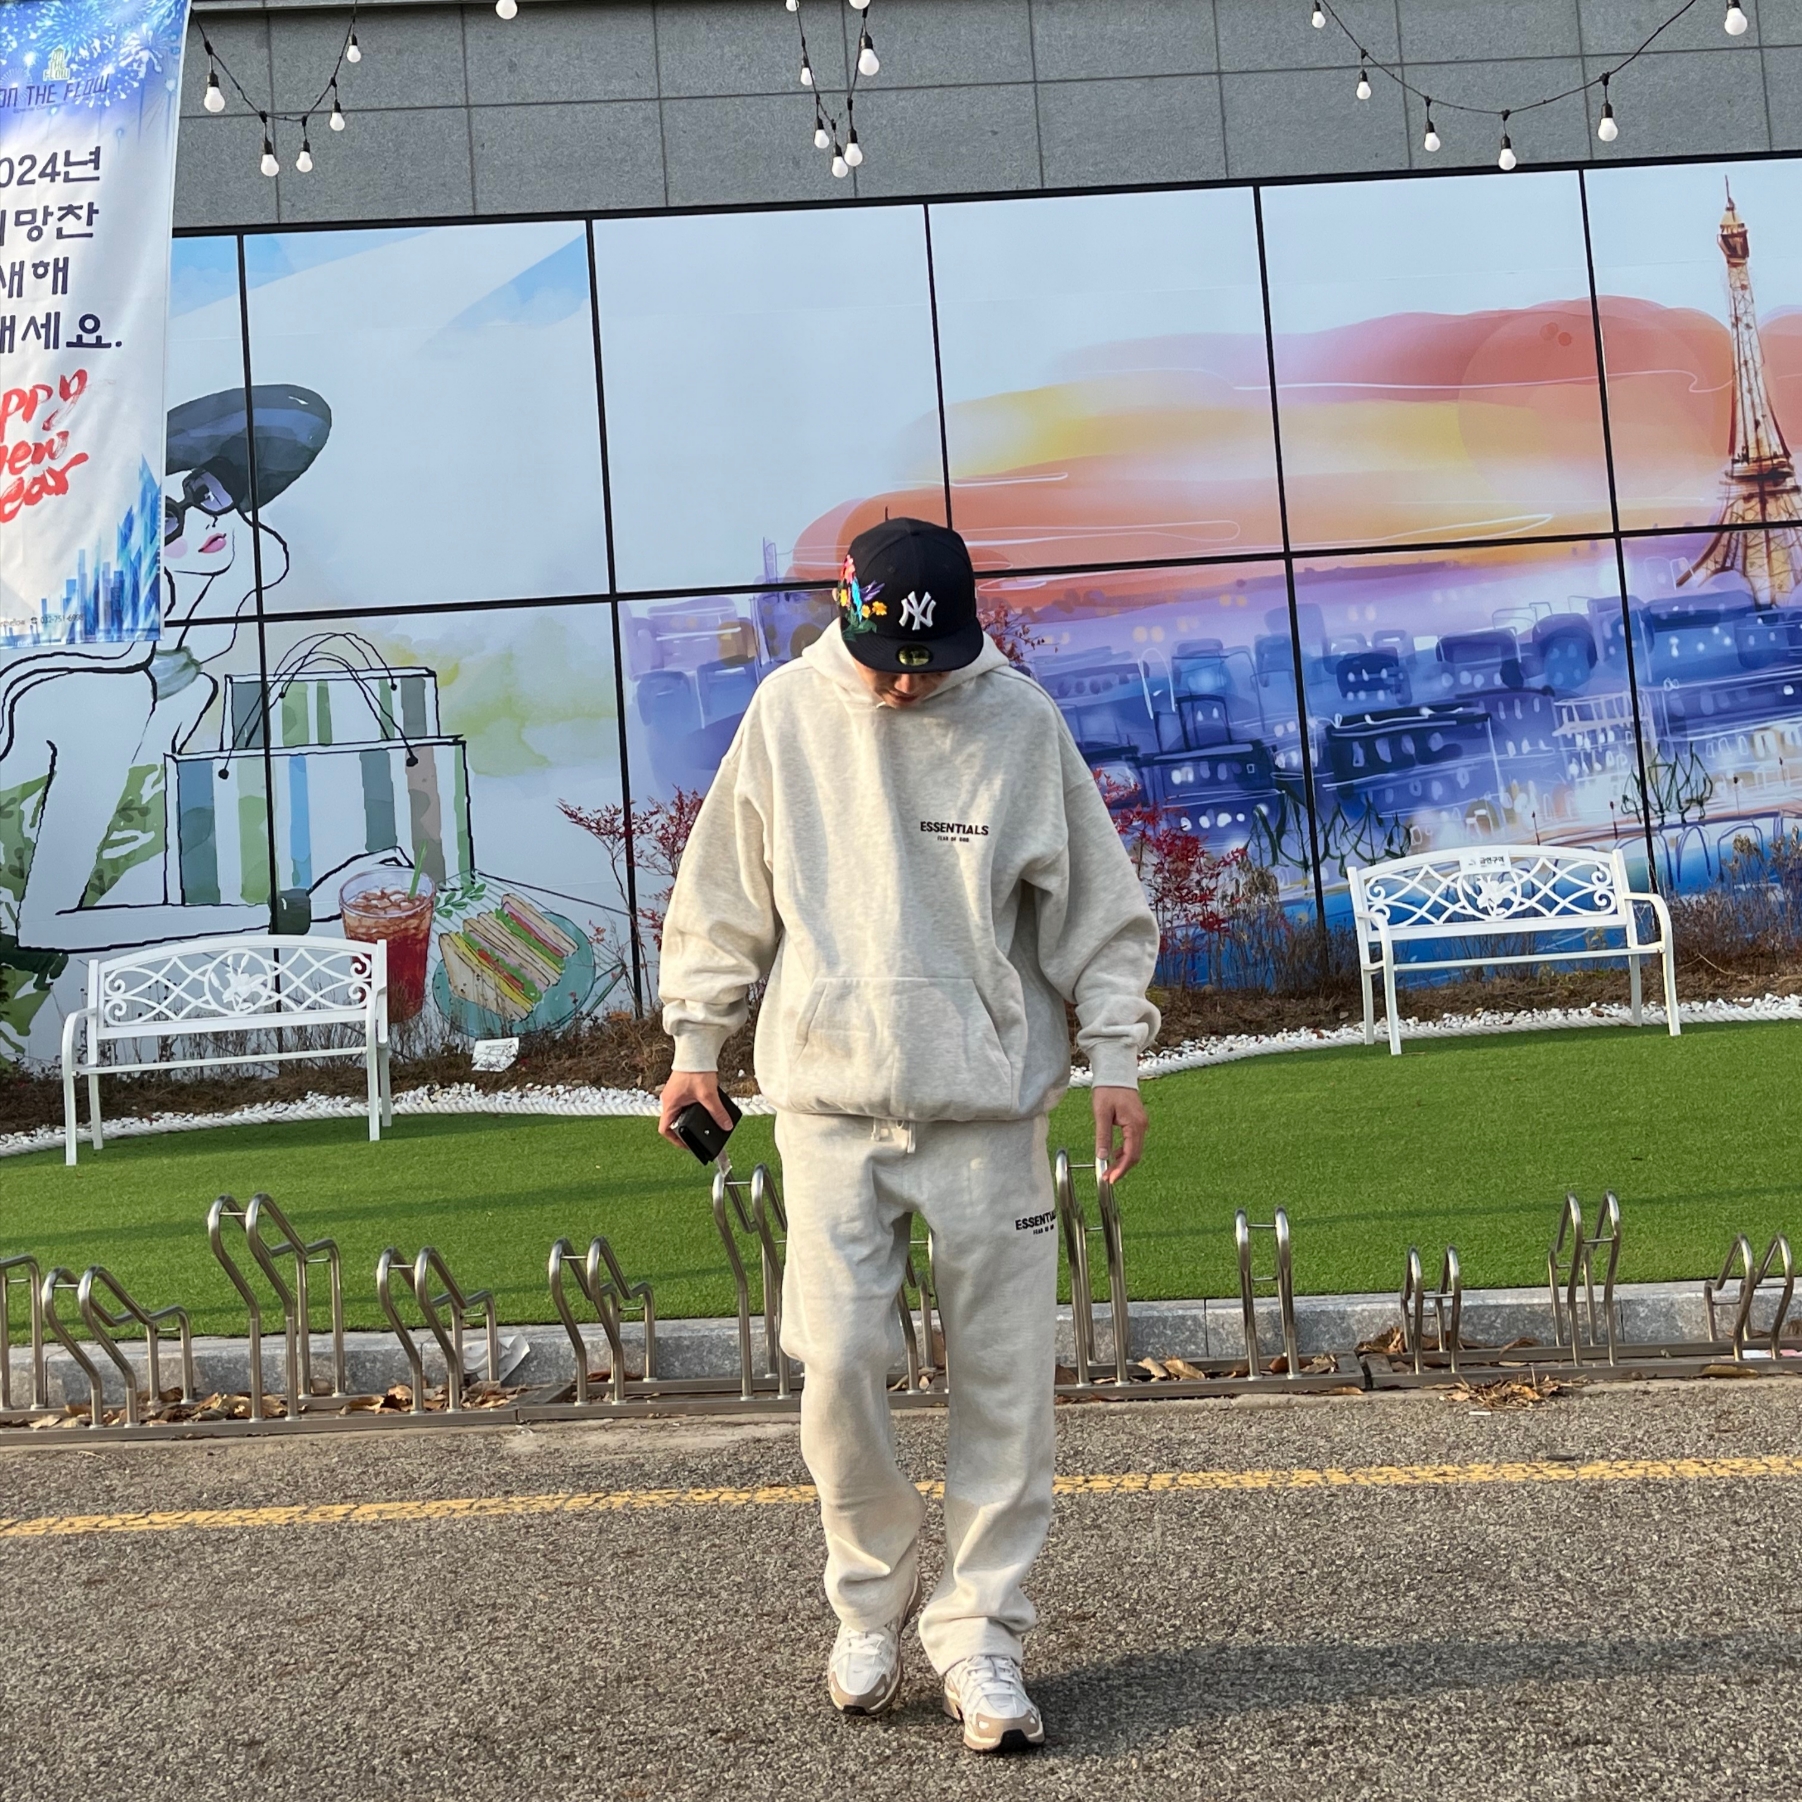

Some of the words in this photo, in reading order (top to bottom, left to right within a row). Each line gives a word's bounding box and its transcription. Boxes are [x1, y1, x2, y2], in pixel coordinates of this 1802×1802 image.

[26, 84, 57, 106] THE
[64, 73, 110, 101] FLOW
[898, 591, 937, 631] NY
[920, 821, 989, 836] ESSENTIALS
